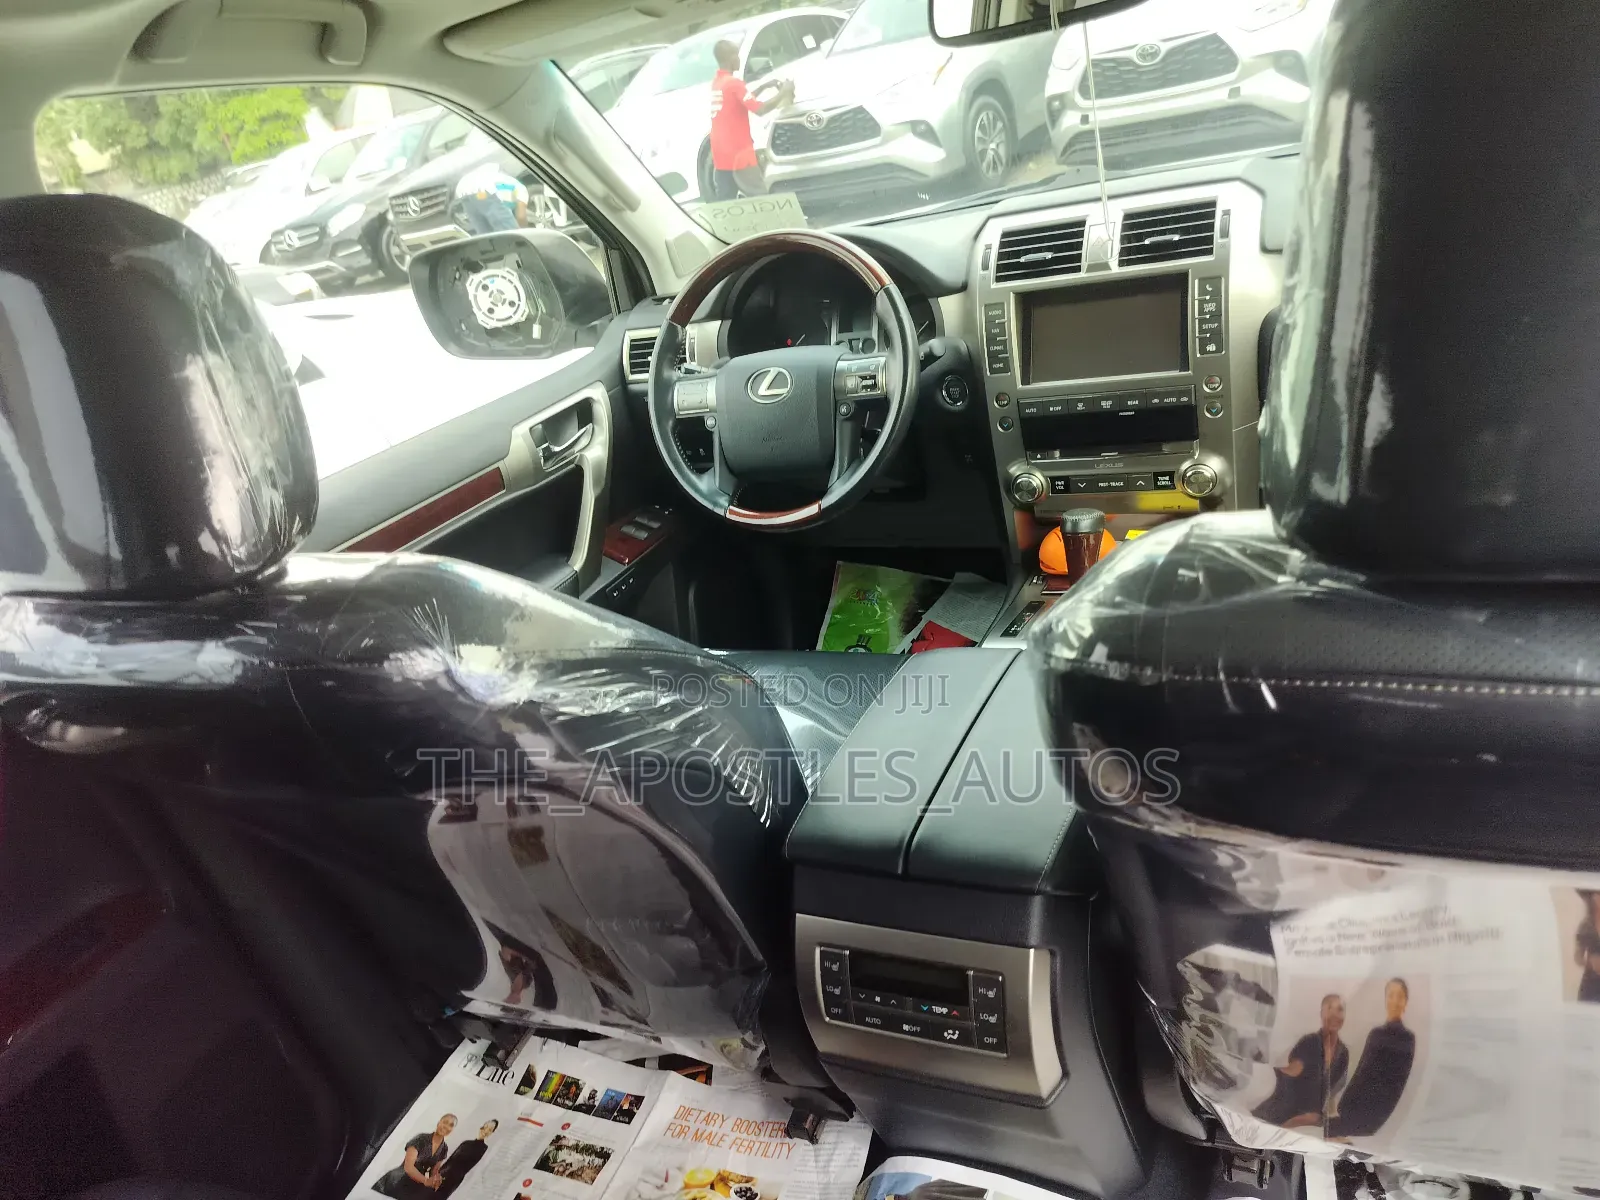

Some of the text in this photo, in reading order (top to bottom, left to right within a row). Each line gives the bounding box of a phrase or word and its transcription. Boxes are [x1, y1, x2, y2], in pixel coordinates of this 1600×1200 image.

[824, 960, 831, 968] HI
[978, 987, 987, 995] HI
[931, 1005, 949, 1015] TEMP
[865, 1017, 882, 1025] AUTO
[979, 1012, 989, 1021] LO
[908, 1025, 921, 1033] OFF
[983, 1036, 998, 1045] OFF
[673, 1105, 730, 1128] DIETARY
[664, 1122, 797, 1160] FOR MALE FERTILITY
